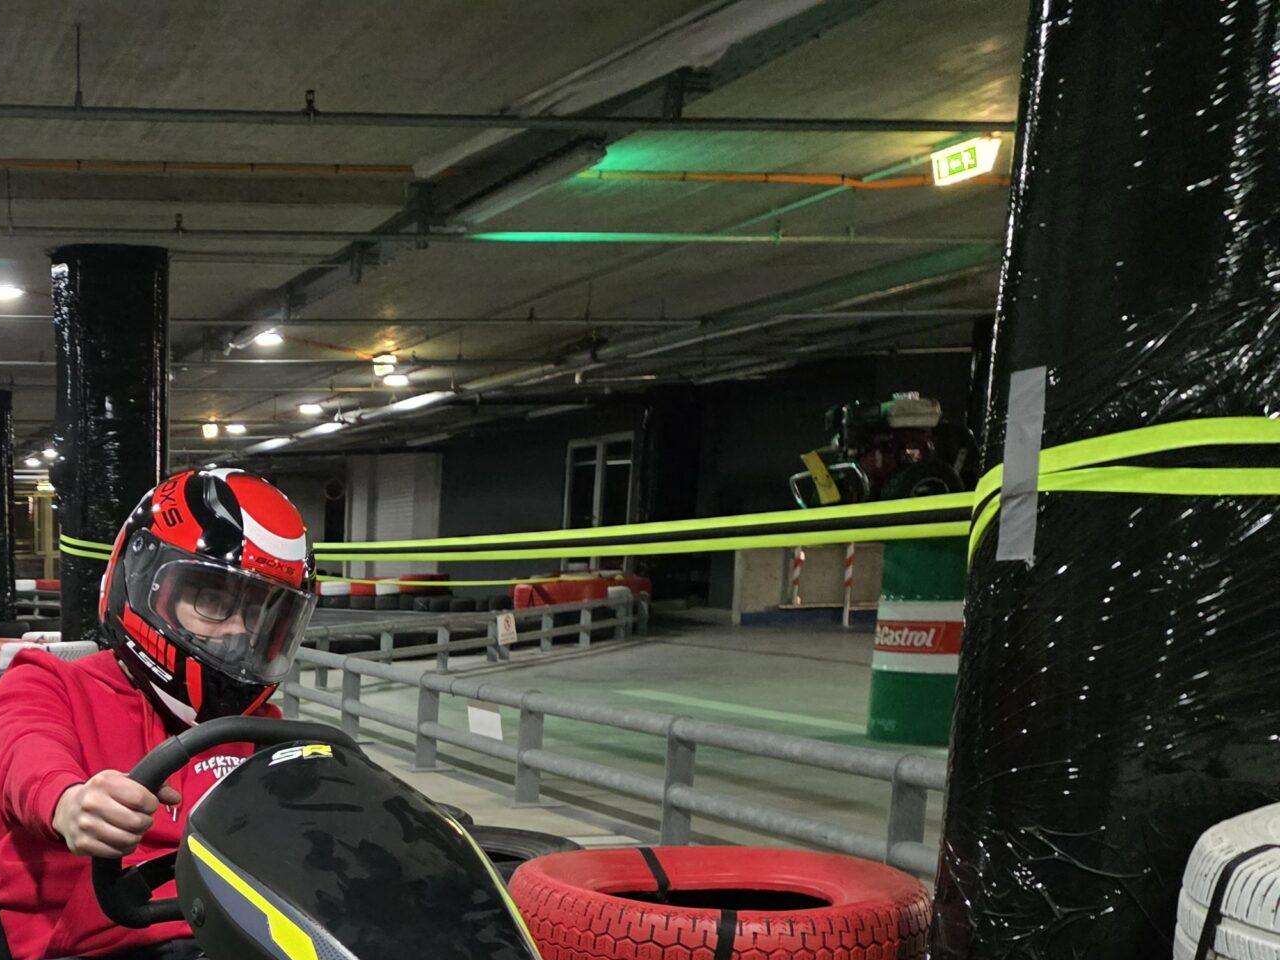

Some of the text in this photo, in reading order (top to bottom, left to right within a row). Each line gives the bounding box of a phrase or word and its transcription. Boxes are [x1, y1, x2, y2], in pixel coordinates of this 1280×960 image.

[254, 556, 296, 576] BOX'S
[879, 625, 937, 648] Castrol
[125, 635, 173, 683] LS2
[268, 744, 333, 767] SR
